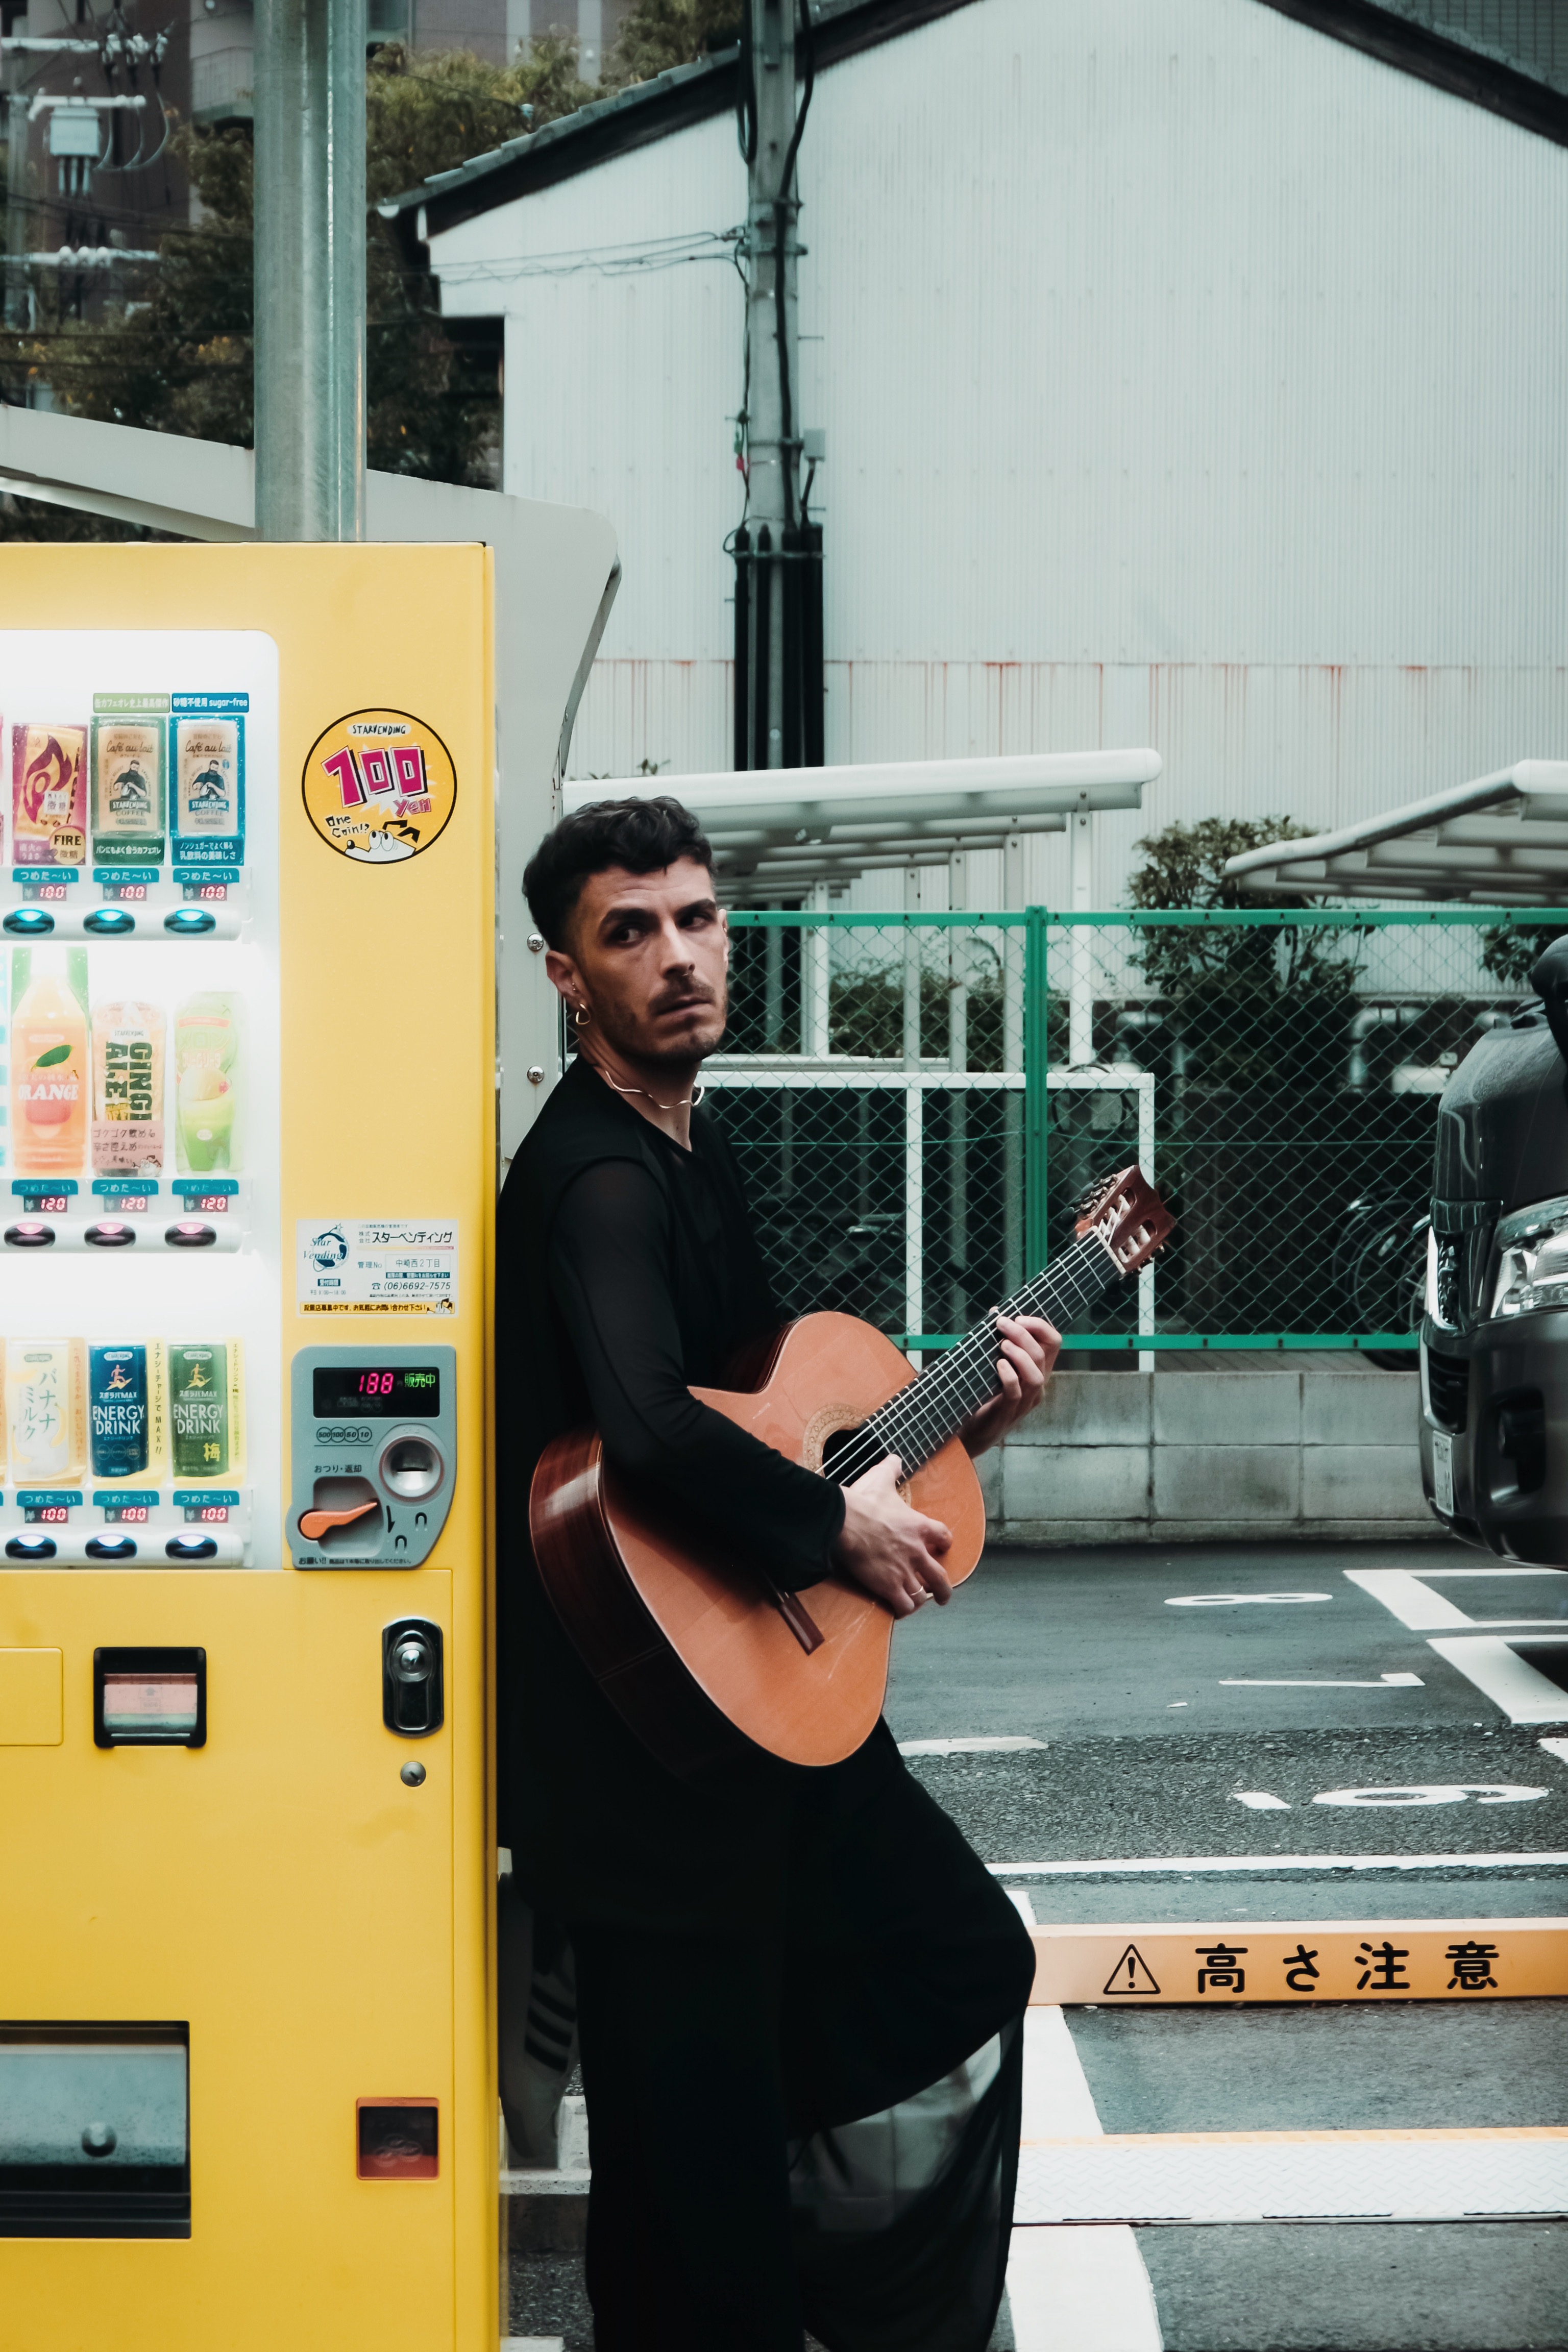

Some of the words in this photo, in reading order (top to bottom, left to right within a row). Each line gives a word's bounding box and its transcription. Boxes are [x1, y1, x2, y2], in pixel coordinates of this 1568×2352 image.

[209, 697, 248, 708] sugar-free
[353, 725, 406, 736] STARVENDING
[139, 742, 154, 753] lait
[219, 741, 232, 752] lait
[321, 745, 428, 808] 100
[393, 798, 432, 818] yen
[325, 816, 352, 827] One
[54, 835, 82, 846] FIRE
[40, 886, 65, 899] 100
[120, 886, 145, 899] 100
[200, 886, 226, 899] 100
[18, 1084, 79, 1100] ORANGE
[41, 1197, 66, 1211] 120
[121, 1197, 146, 1211] 120
[201, 1197, 226, 1211] 120
[310, 1237, 331, 1246] Star
[303, 1251, 344, 1261] Vending
[384, 1282, 451, 1291] (06)6692-7575
[404, 1372, 435, 1388] 販売中
[39, 1368, 57, 1434] バナナ
[23, 1385, 38, 1441] ミルク
[92, 1405, 144, 1420] ENERGY
[174, 1404, 224, 1419] ENERGY
[96, 1420, 141, 1435] DRINK
[177, 1419, 220, 1434] DRINK
[203, 1442, 220, 1462] 梅
[314, 1464, 362, 1473] おつり・返却
[41, 1507, 67, 1521] 100
[121, 1507, 146, 1521] 100
[201, 1507, 227, 1521] 100
[1195, 1941, 1499, 1995] 高さ注意
